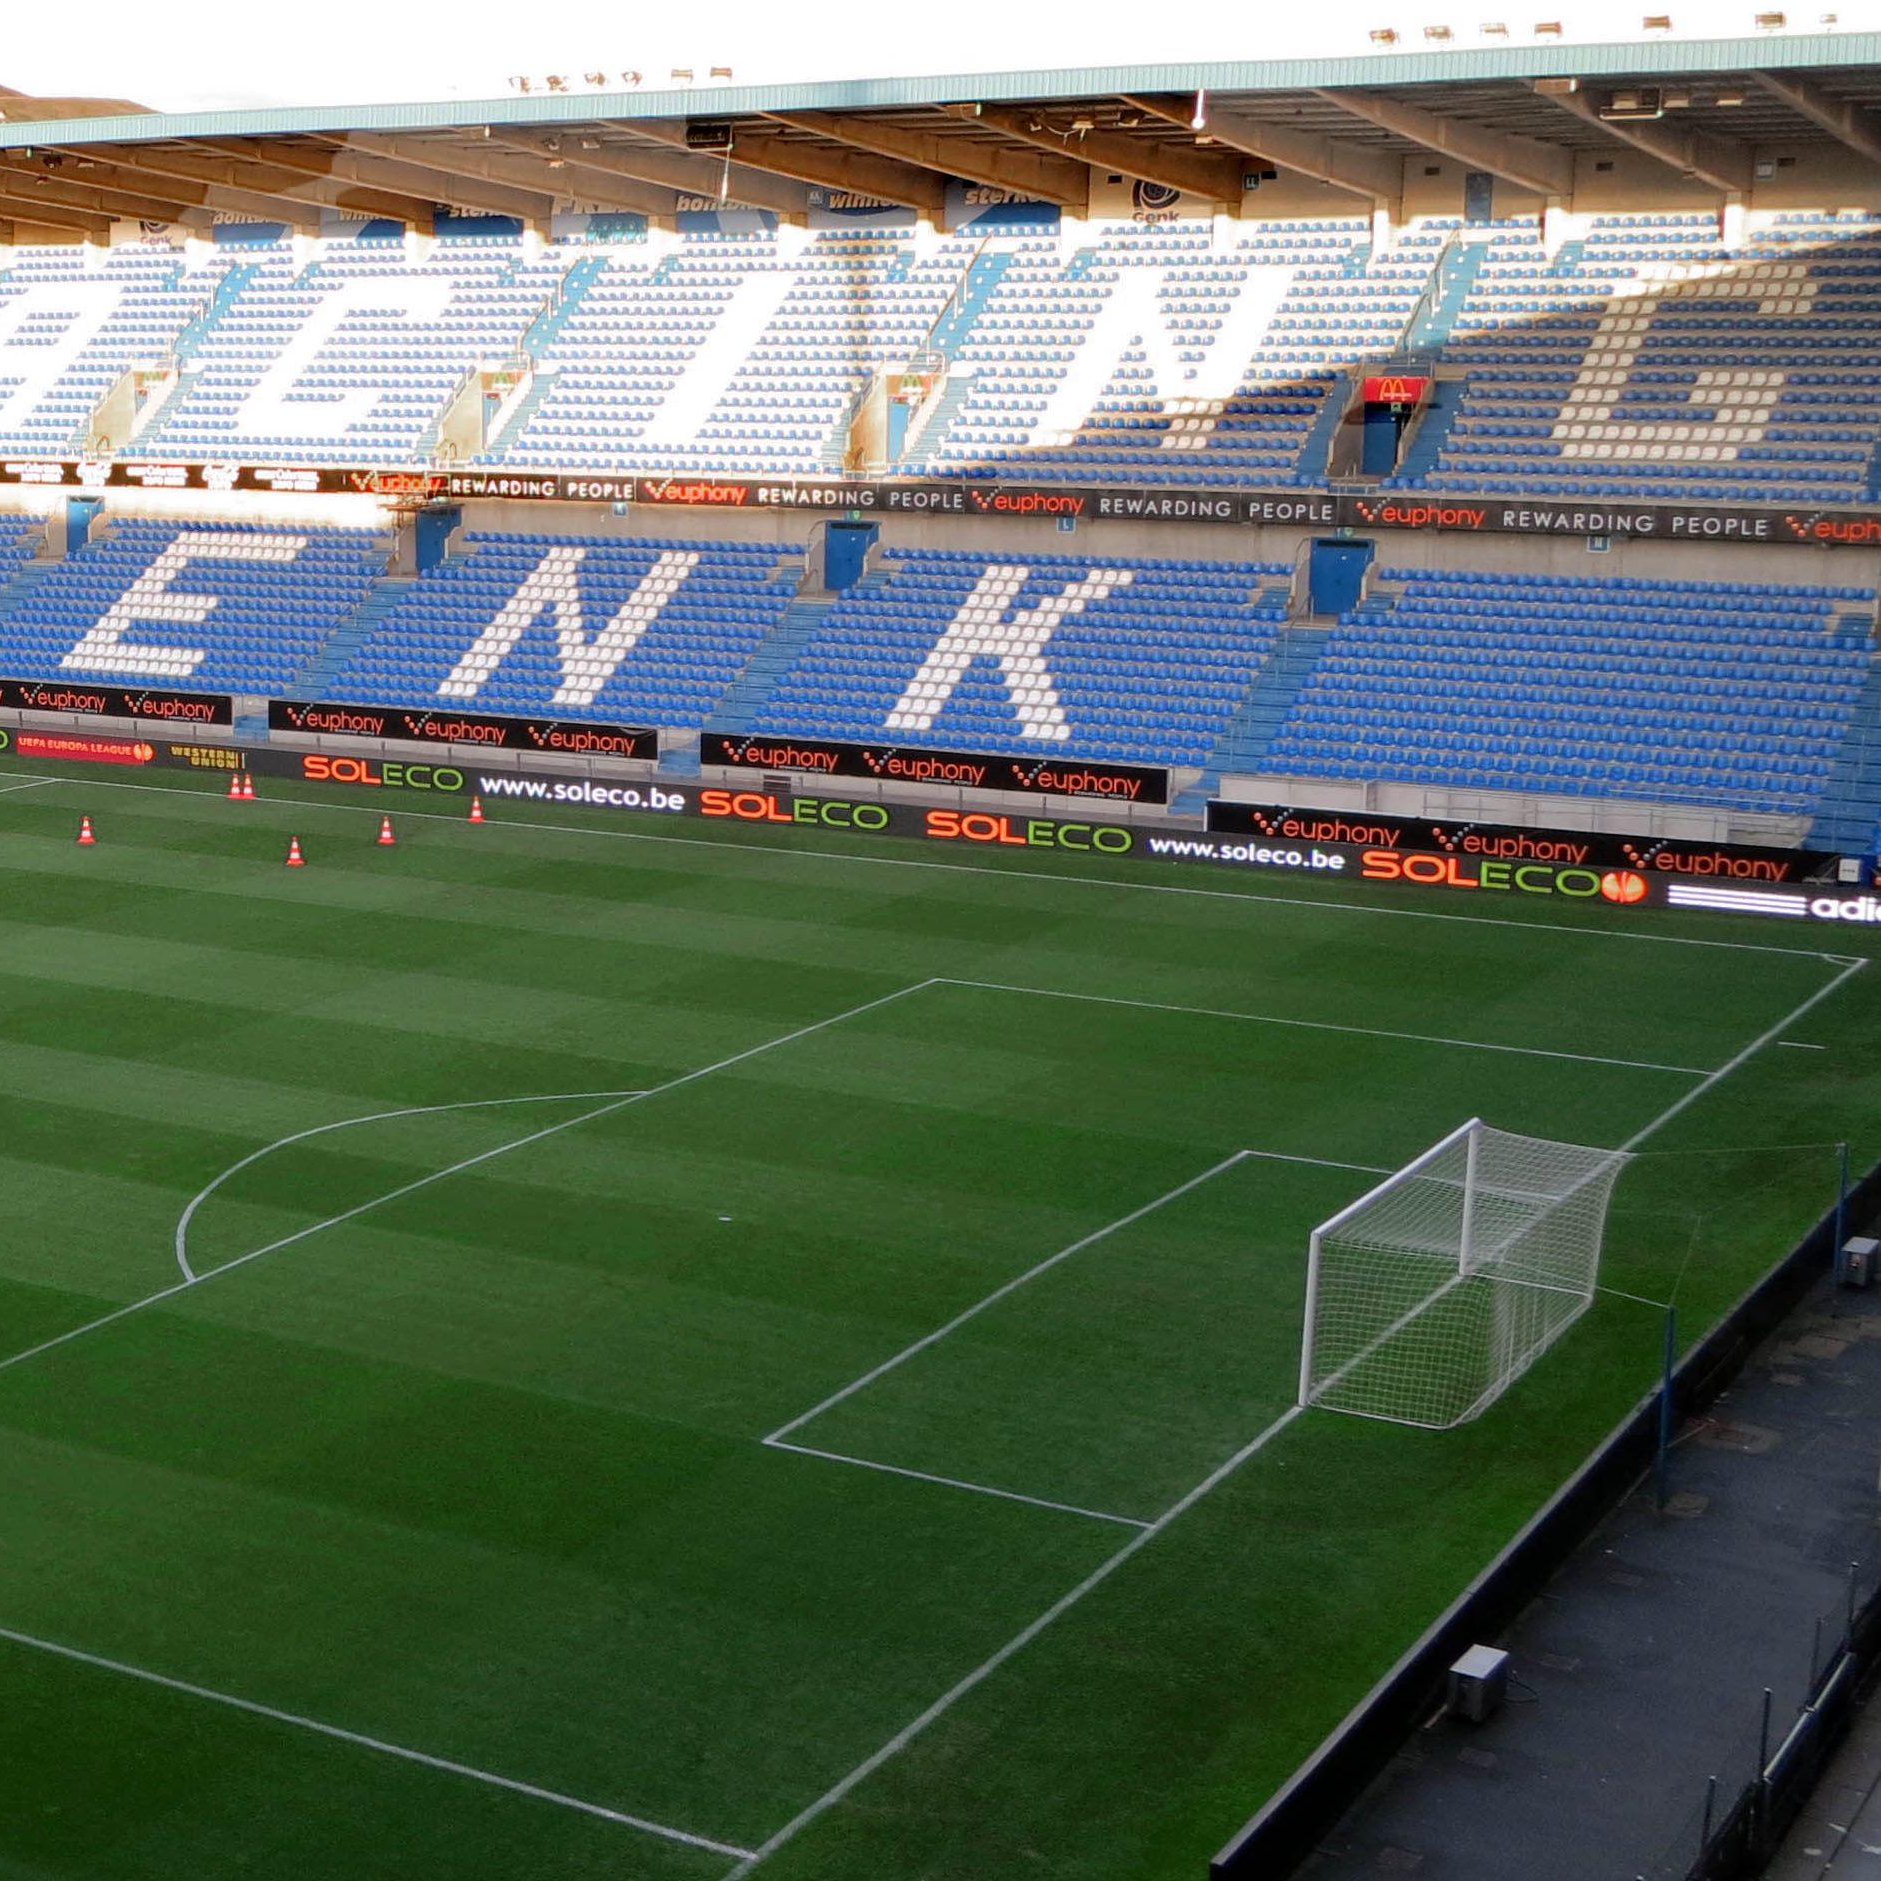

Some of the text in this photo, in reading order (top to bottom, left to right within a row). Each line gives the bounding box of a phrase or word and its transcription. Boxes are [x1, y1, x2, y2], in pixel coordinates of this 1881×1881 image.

[1133, 211, 1180, 223] Genk
[451, 478, 555, 497] REWARDING
[567, 482, 633, 499] PEOPLE
[666, 482, 747, 506] euphony
[758, 487, 875, 507] REWARDING
[890, 491, 963, 509] PEOPLE
[994, 489, 1084, 514] euphony
[1100, 497, 1232, 517] REWARDING
[1250, 502, 1333, 521] PEOPLE
[1382, 503, 1486, 529] euphony
[1503, 509, 1654, 533] REWARDING
[1672, 515, 1768, 537] PEOPLE
[37, 690, 106, 714] euphony
[142, 698, 215, 722] euphony
[19, 737, 132, 756] UEFA EUROPA LEAGUE
[306, 711, 636, 756] euphony euphony euphony
[171, 746, 236, 760] WESTERN
[190, 757, 236, 769] UNION
[746, 743, 1141, 799] euphony euphony euphony
[302, 754, 1602, 897] SOLECO www.soleco.be SOLECO SOLECO www.soleco.be SOLECO
[1282, 818, 1789, 881] euphony euphony euphony
